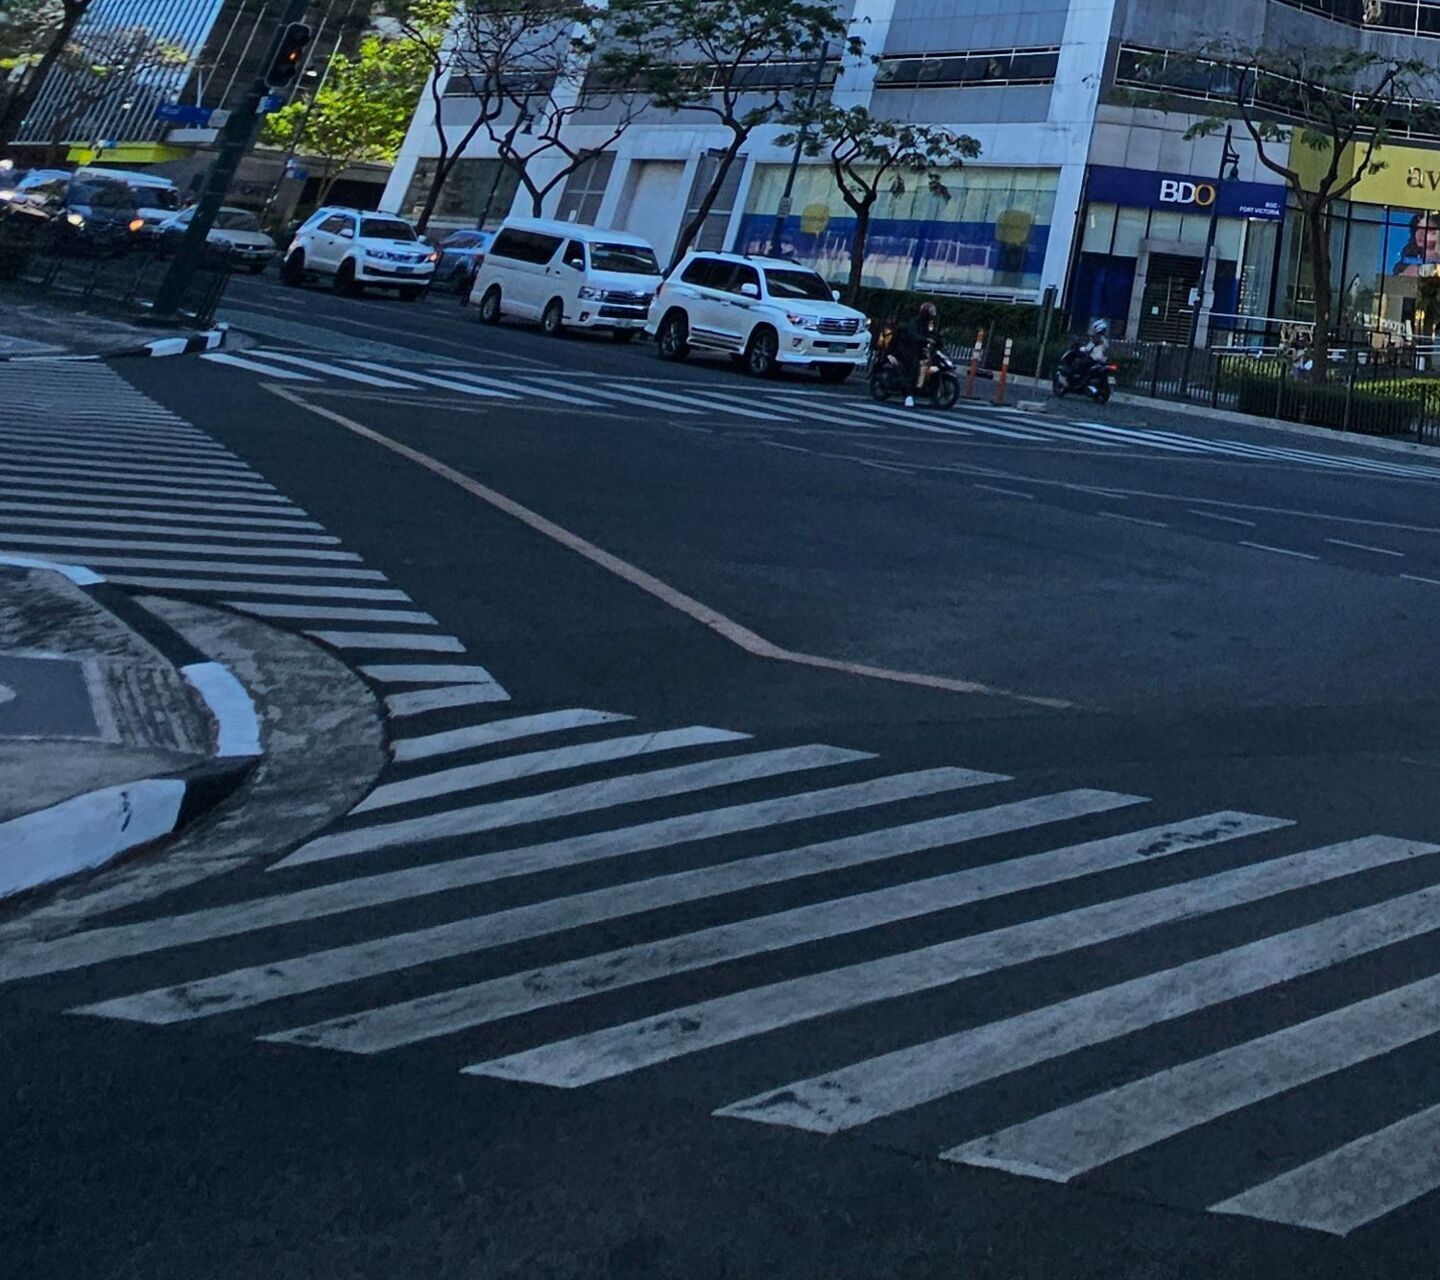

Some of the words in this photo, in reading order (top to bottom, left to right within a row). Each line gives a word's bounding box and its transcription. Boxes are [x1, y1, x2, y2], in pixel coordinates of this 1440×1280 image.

[1159, 180, 1216, 206] BDO
[1239, 205, 1254, 213] FORT
[1254, 207, 1281, 216] VICTORIA
